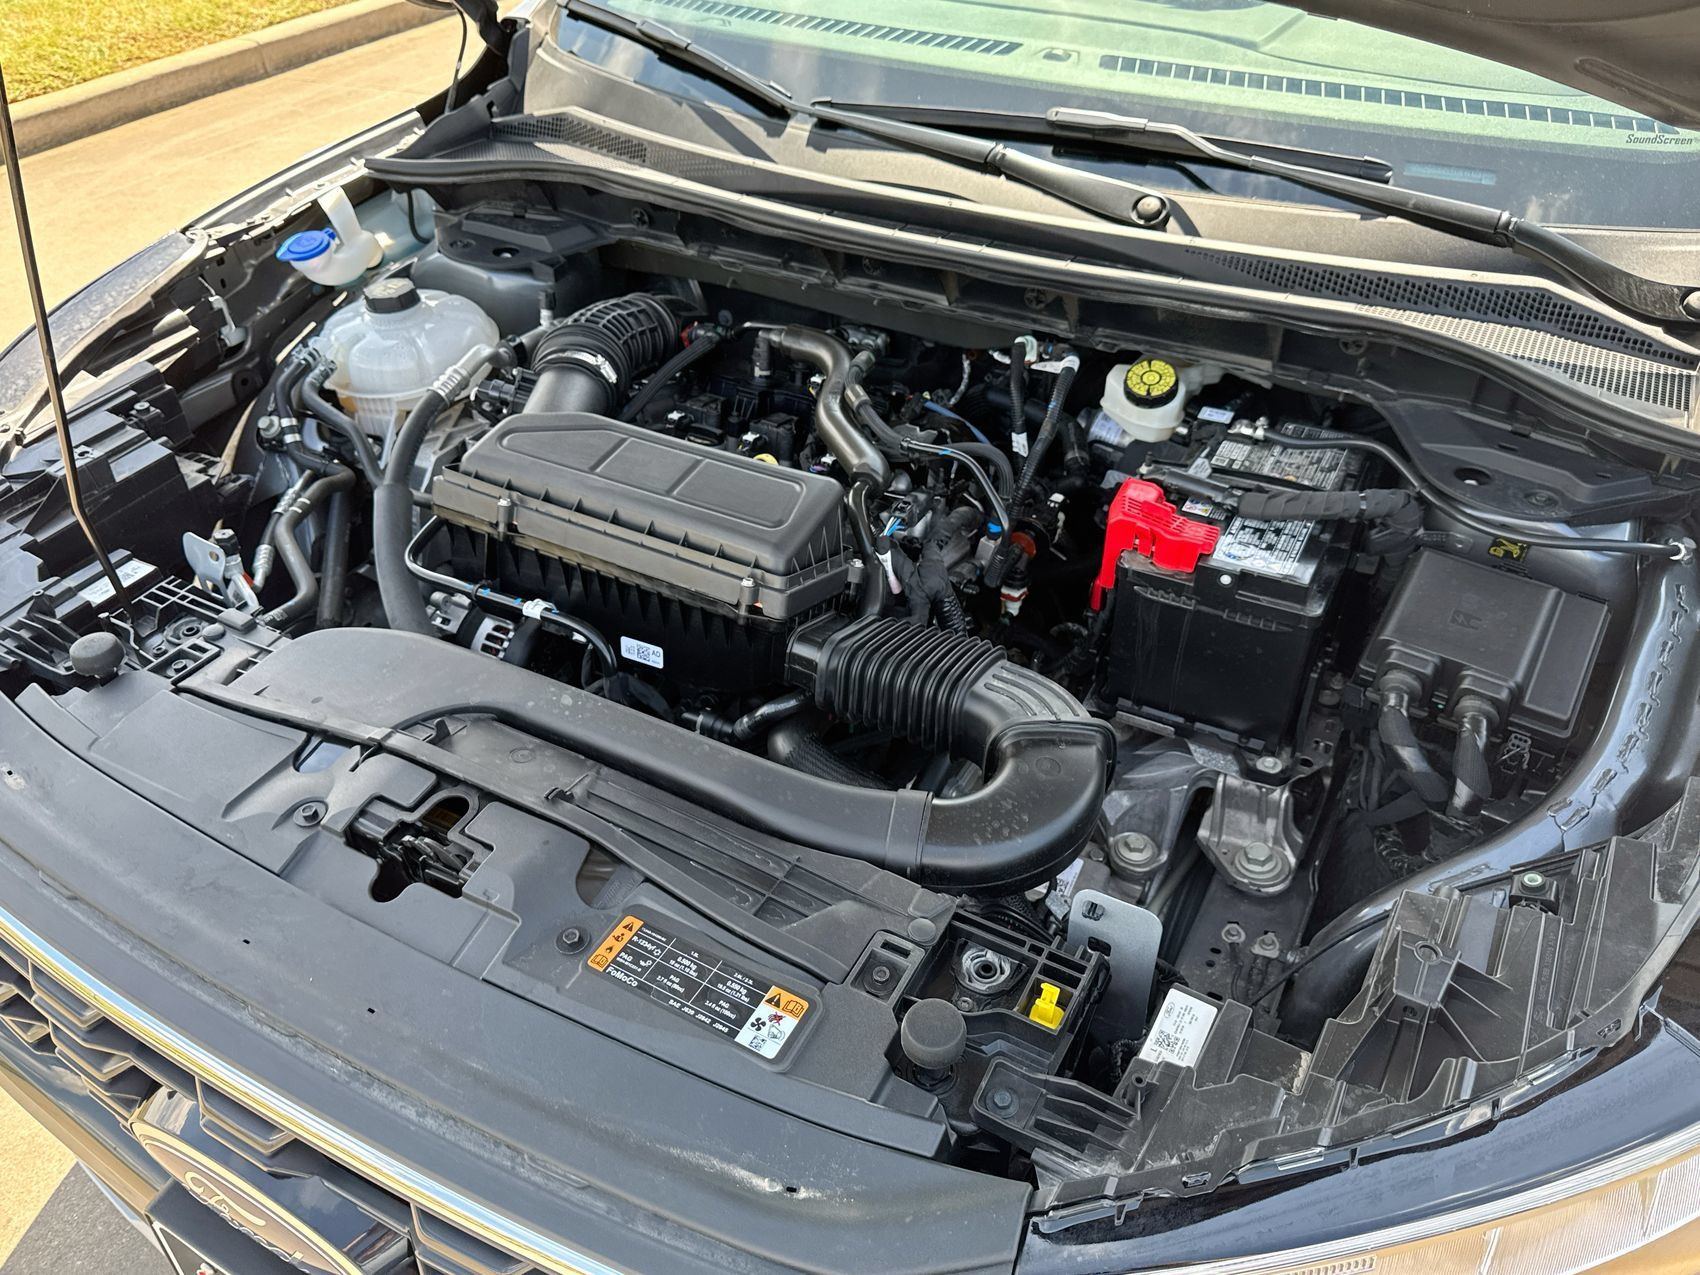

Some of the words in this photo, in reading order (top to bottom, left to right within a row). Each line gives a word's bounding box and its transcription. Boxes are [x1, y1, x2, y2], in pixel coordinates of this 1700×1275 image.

[1626, 133, 1693, 145] SoundScreen
[618, 952, 633, 962] PAG
[606, 966, 638, 987] FoMoCo
